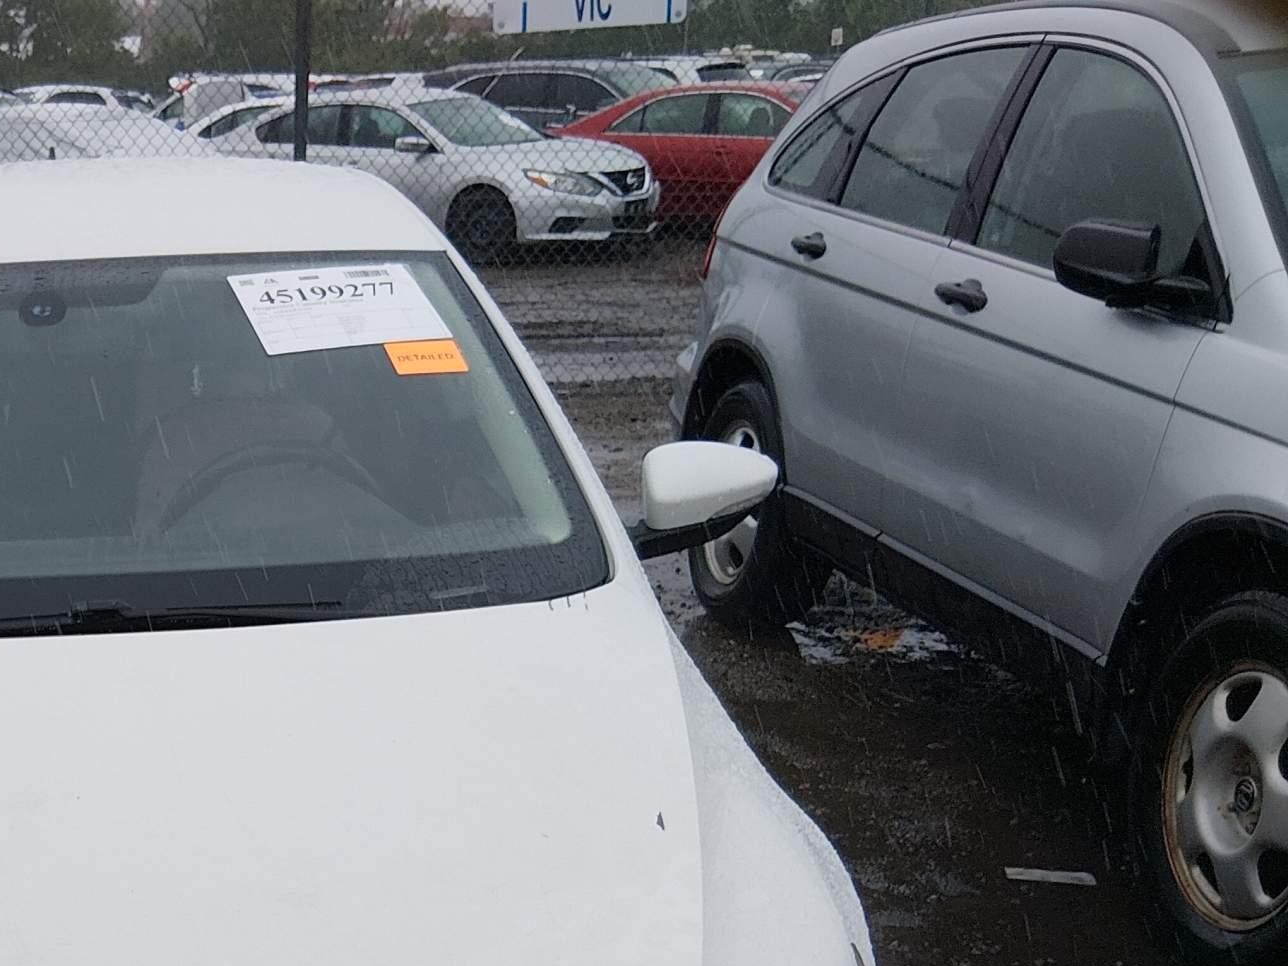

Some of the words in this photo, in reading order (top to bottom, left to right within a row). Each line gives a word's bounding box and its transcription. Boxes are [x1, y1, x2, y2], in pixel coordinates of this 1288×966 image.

[575, 0, 612, 22] VIC
[259, 281, 394, 305] 45199277
[397, 352, 455, 363] DETAILED
